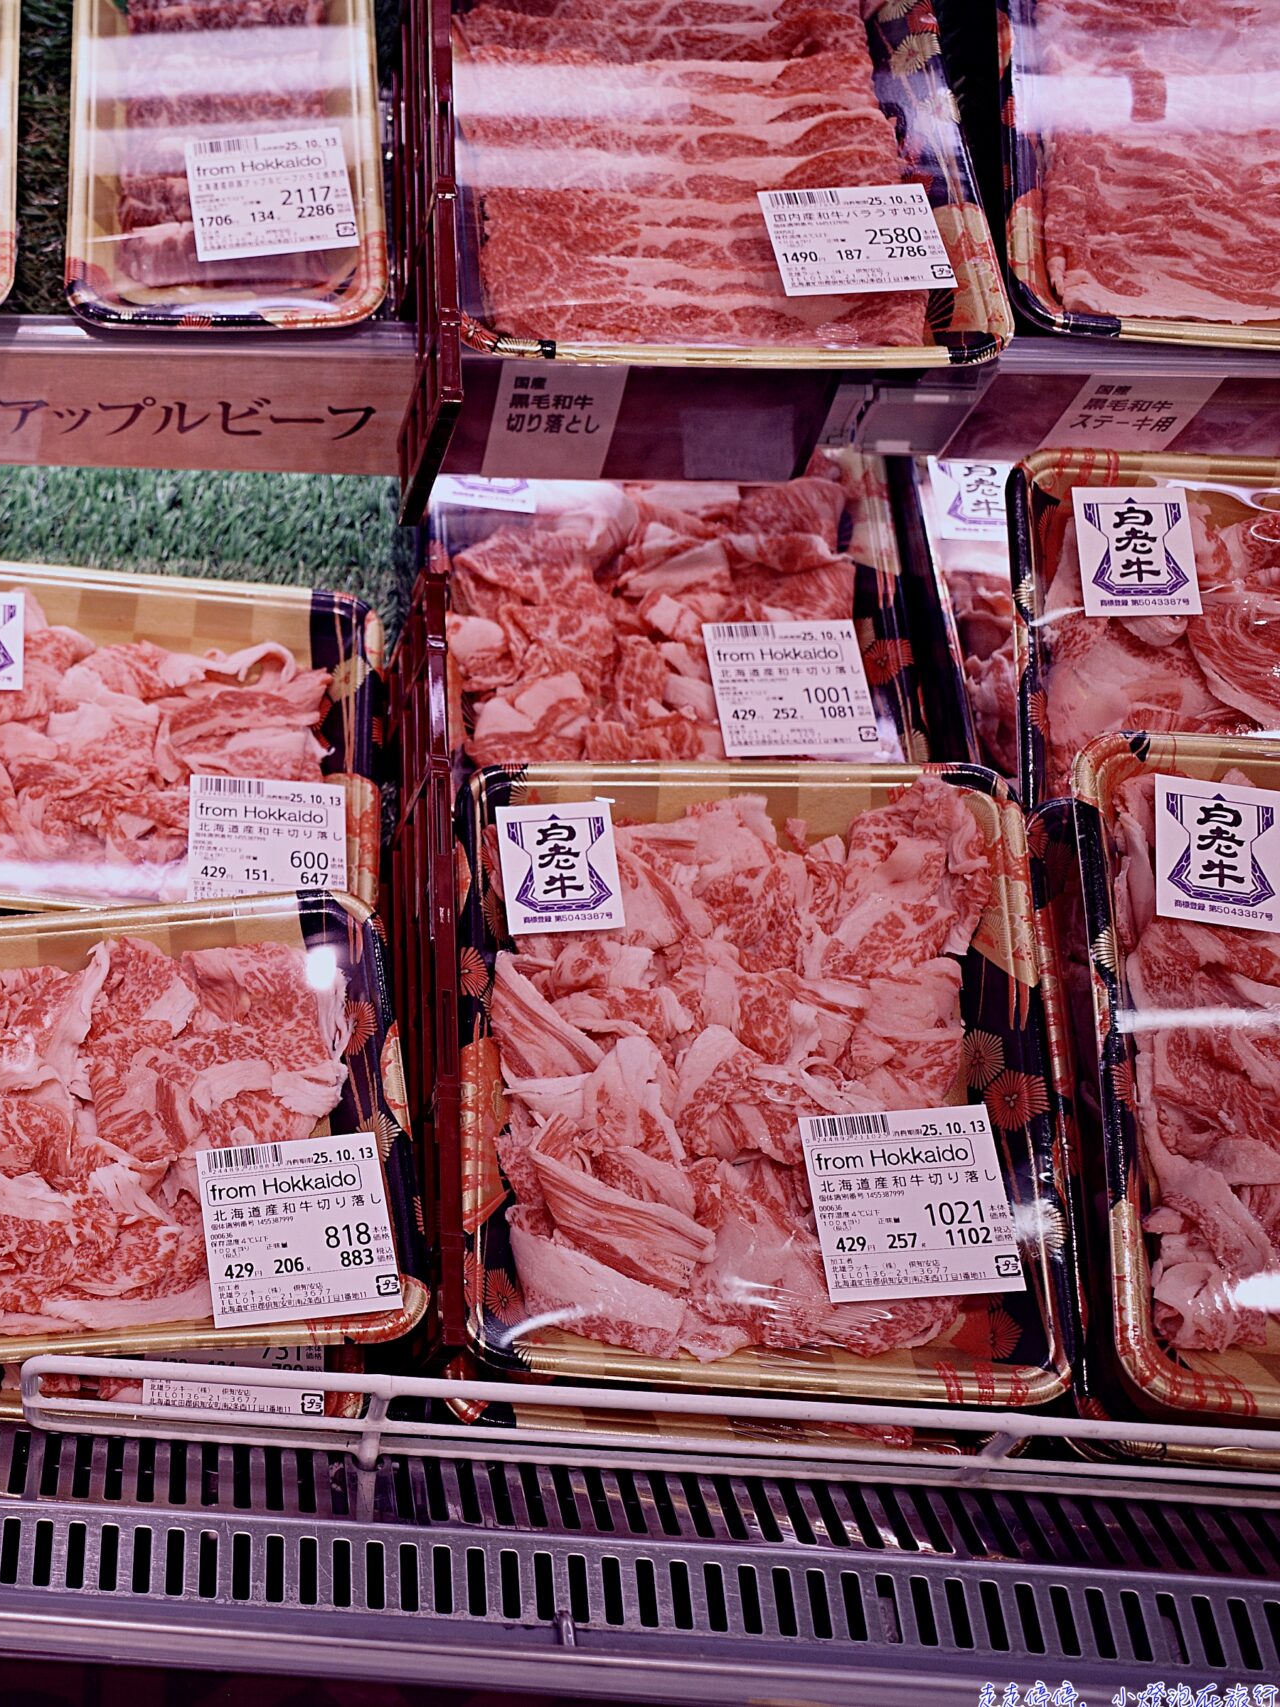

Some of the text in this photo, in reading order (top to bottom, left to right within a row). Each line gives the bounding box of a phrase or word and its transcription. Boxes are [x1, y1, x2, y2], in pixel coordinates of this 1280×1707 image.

[197, 155, 322, 177] from Hokkaido
[281, 186, 331, 206] 2117
[297, 204, 335, 219] 2286
[865, 227, 922, 245] 2580
[886, 245, 927, 259] 2786
[514, 376, 547, 389] 国産
[1095, 384, 1132, 395] 国産
[509, 394, 594, 410] 黒毛和牛
[1082, 398, 1174, 413] 黒毛和牛
[506, 414, 600, 433] 切り落とし
[1070, 414, 1177, 432] ステーキ用
[1113, 506, 1161, 583] 白老牛
[717, 648, 838, 662] from Hokkaido
[803, 686, 850, 704] 1001
[820, 706, 854, 719] 1081
[199, 803, 324, 824] from Hokkaido
[199, 823, 342, 841] 北海道産和牛切り落し
[1196, 803, 1246, 888] 白老牛
[290, 851, 328, 870] 600
[535, 822, 585, 899] 白老牛
[301, 872, 328, 886] 647
[815, 1143, 969, 1171] from Hokkaido
[210, 1170, 356, 1201] from Hokkaido
[821, 1169, 997, 1193] 北海道産和牛切り落し
[213, 1193, 382, 1221] 北海道産和牛切り落し
[924, 1200, 985, 1227] 1021
[325, 1222, 370, 1248] 818
[946, 1226, 993, 1246] 1102
[340, 1249, 374, 1267] 883
